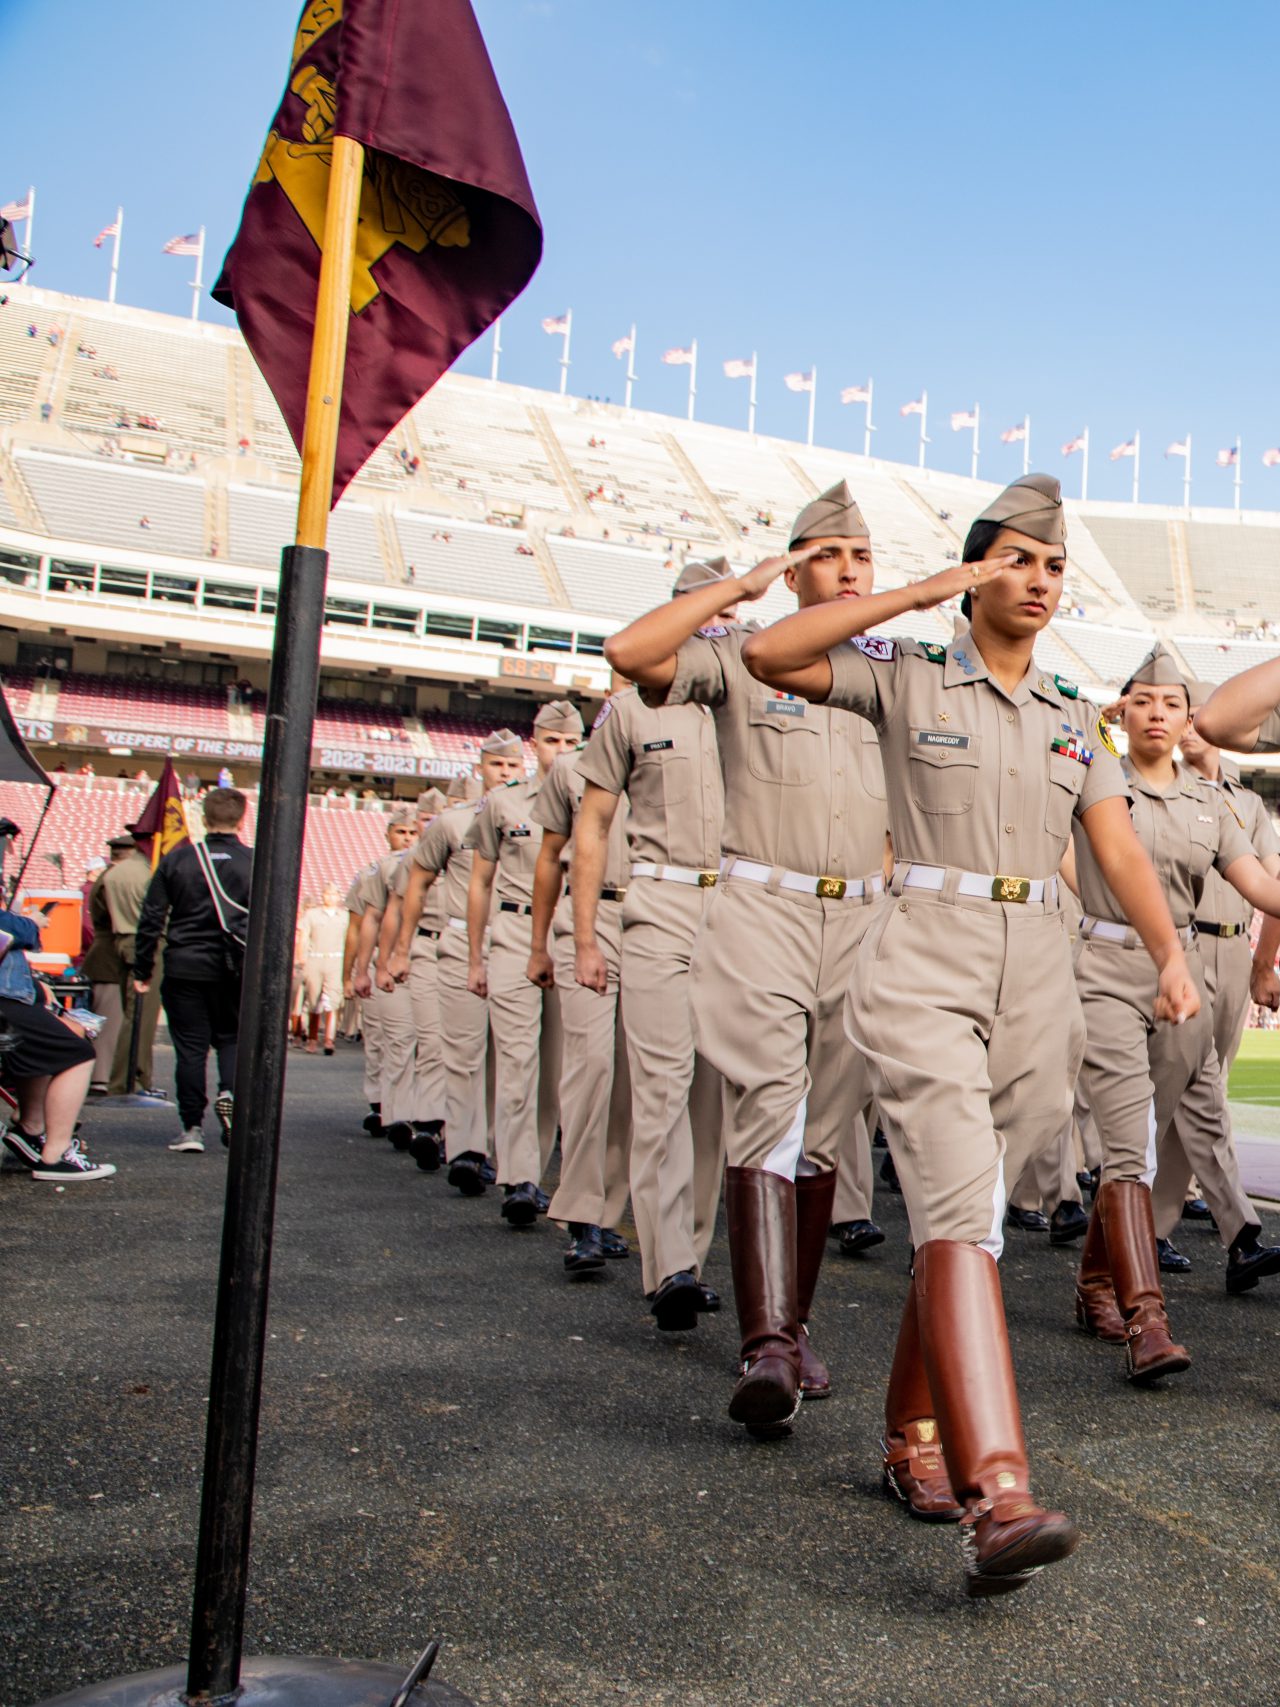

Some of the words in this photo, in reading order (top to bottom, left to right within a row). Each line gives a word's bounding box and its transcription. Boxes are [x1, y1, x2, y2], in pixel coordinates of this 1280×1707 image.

[16, 719, 53, 741] ETS
[174, 738, 195, 752] OF
[196, 739, 224, 755] THE
[320, 750, 417, 774] 2022-2023
